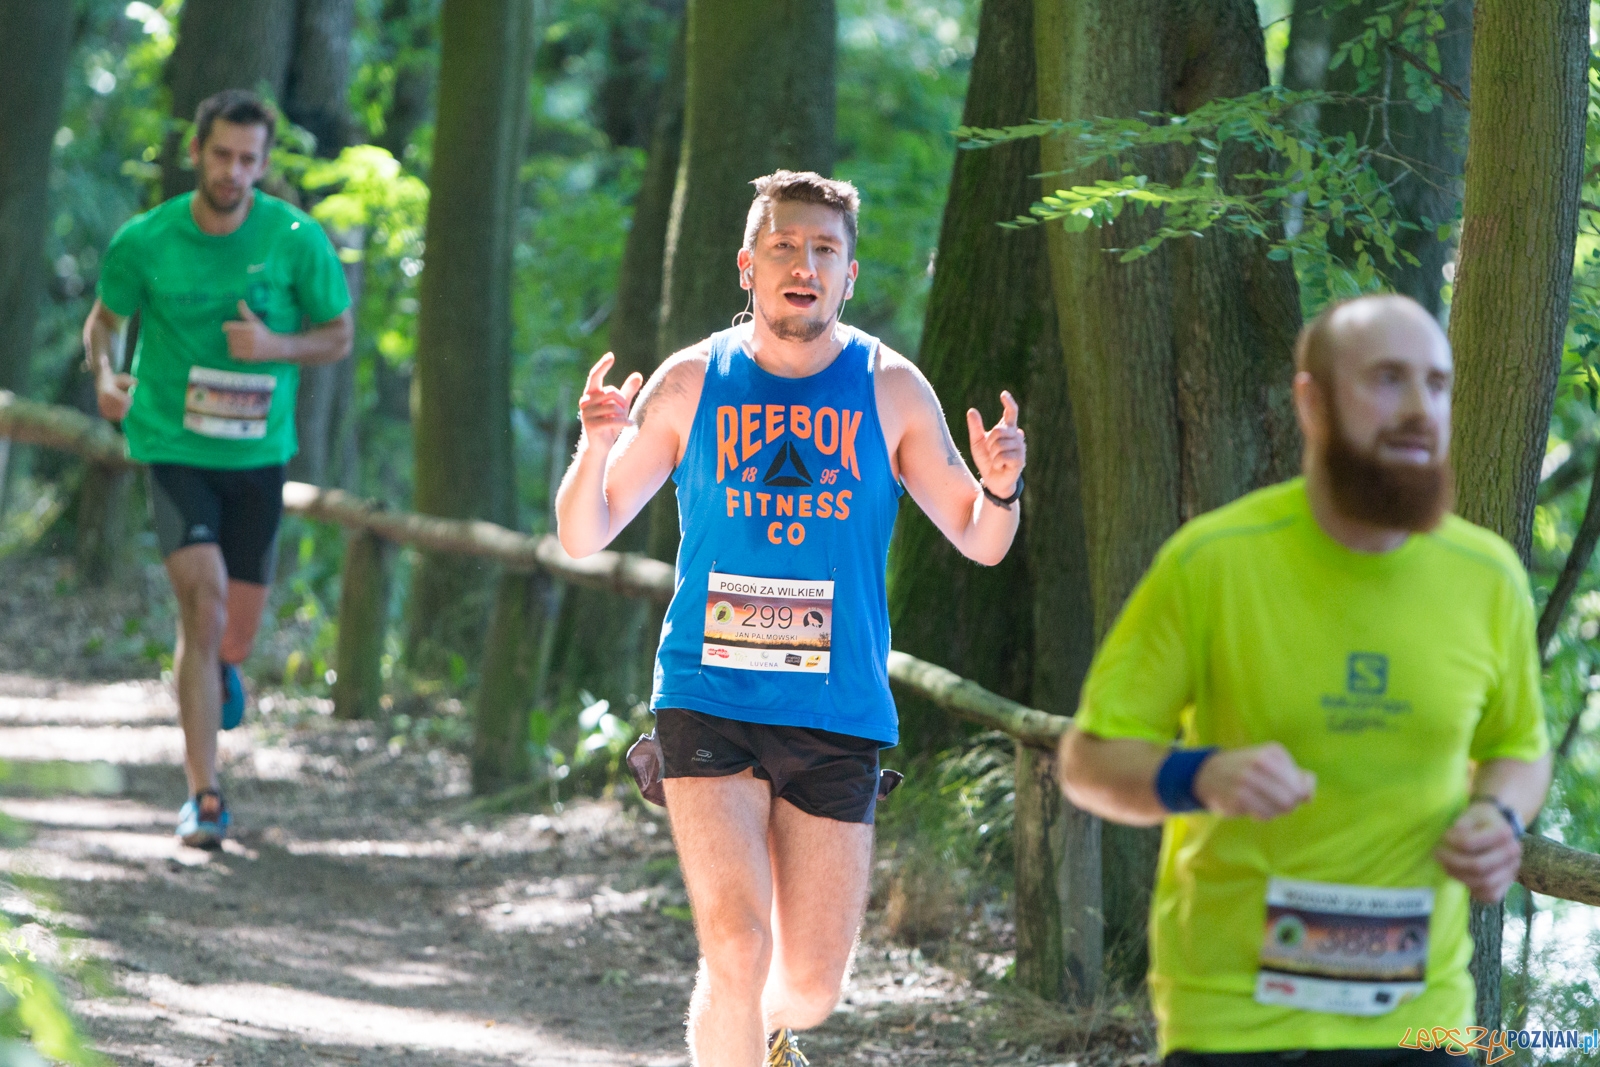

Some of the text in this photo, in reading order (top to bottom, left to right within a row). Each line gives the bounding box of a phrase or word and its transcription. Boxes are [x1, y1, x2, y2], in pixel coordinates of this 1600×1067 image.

[716, 404, 863, 484] REEBOK
[741, 466, 840, 485] 18 95
[726, 486, 853, 520] FITNESS
[767, 521, 806, 546] CO
[720, 581, 824, 598] POGOŃ ZA WILKIEM
[741, 603, 793, 630] 299
[735, 631, 798, 641] JAN PALMOWSKI
